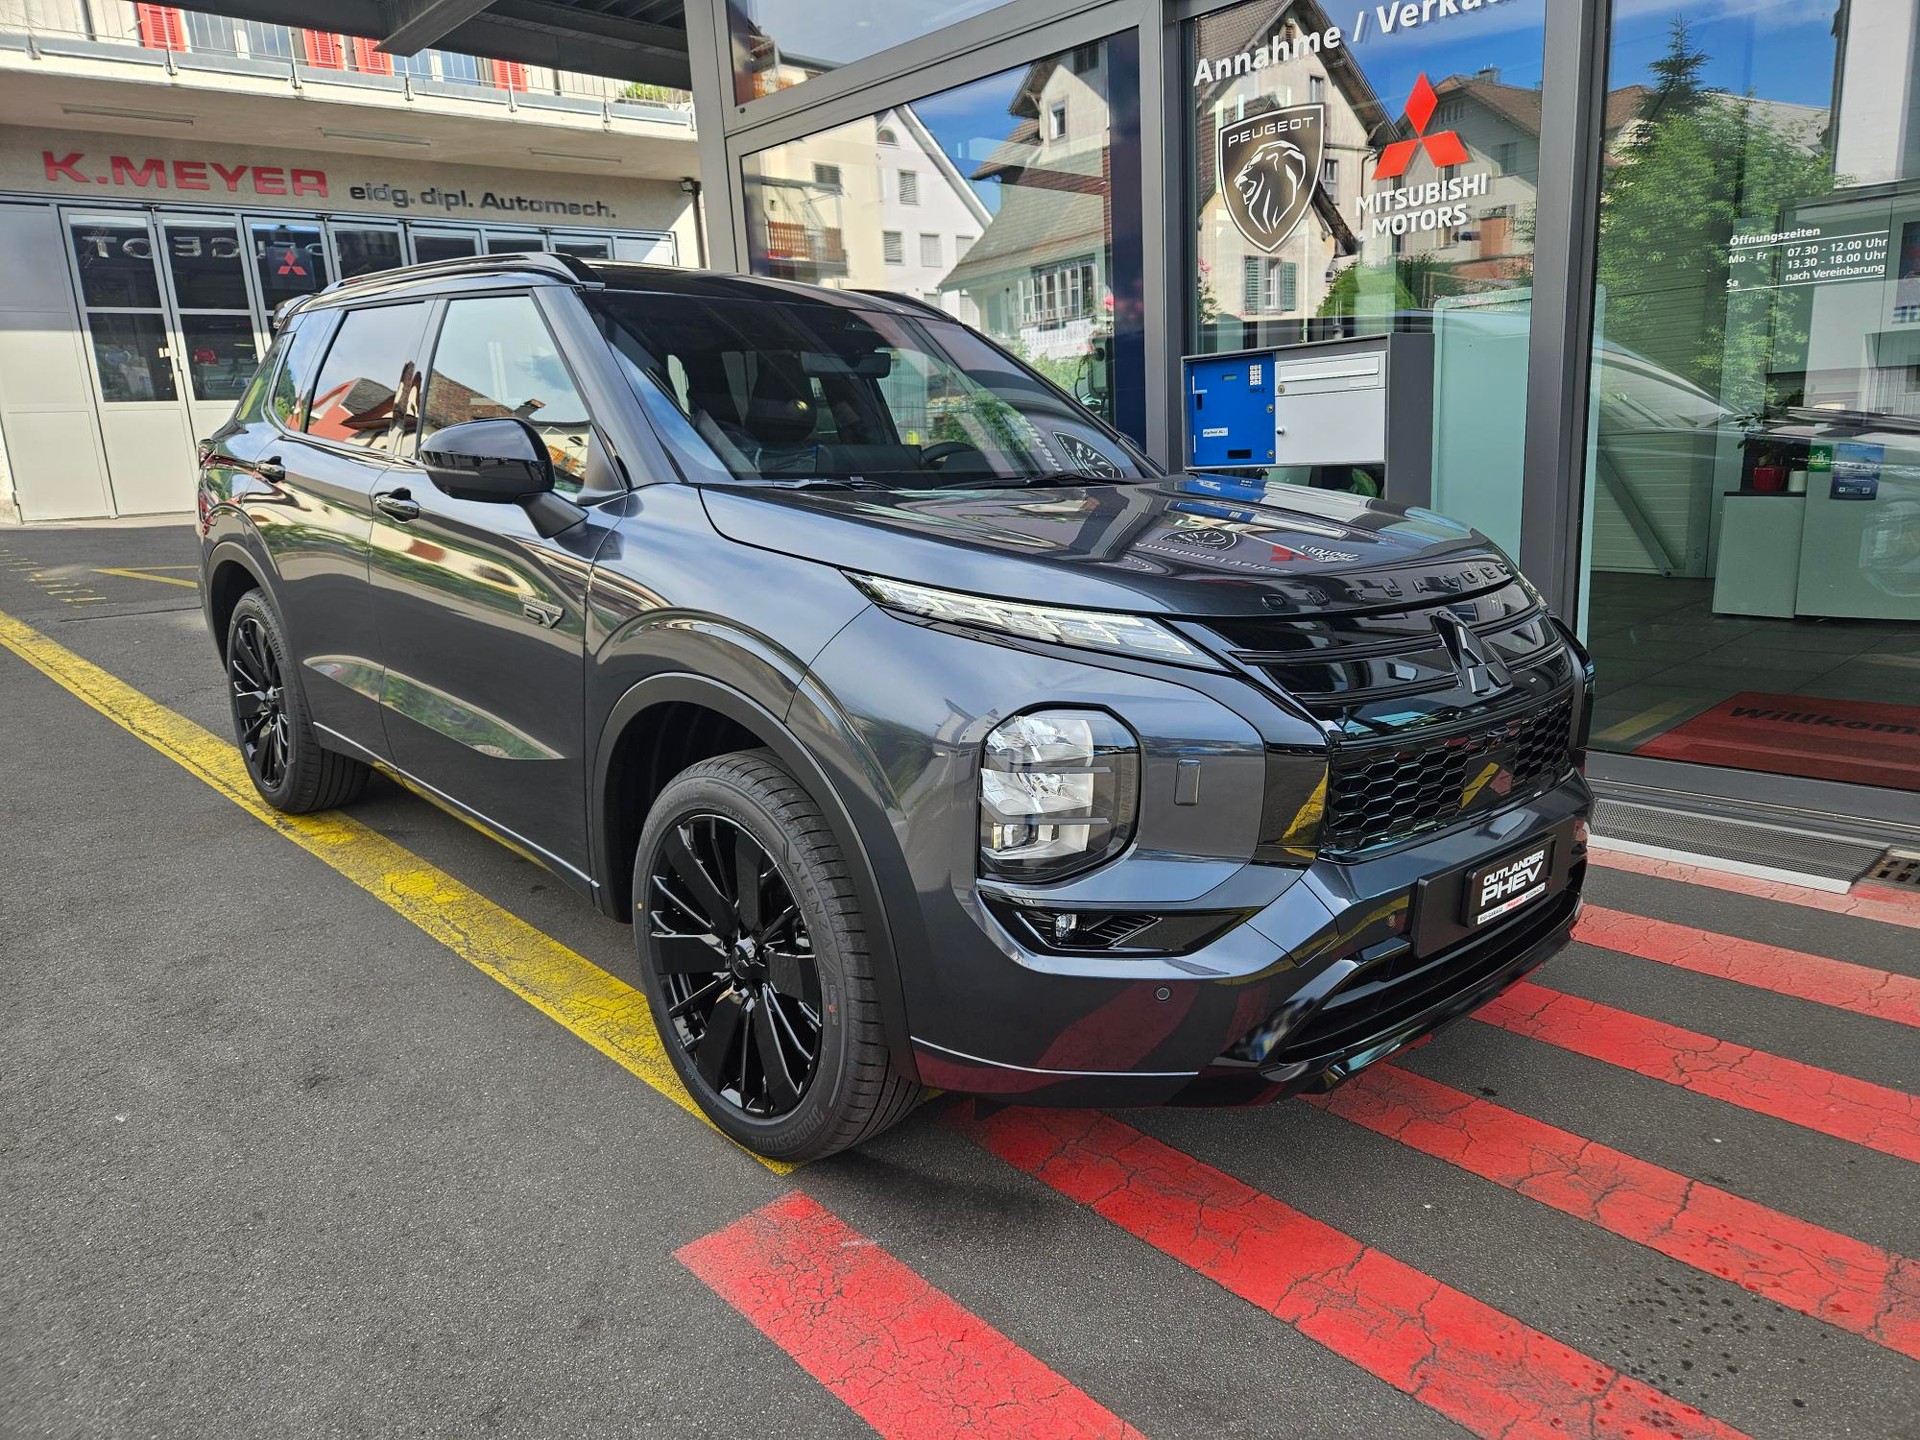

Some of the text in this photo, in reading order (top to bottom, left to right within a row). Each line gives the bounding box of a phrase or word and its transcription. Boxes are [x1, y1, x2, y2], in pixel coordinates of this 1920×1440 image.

[1193, 0, 1501, 86] Annahme / Verka
[1228, 116, 1314, 147] PEUGEOT
[42, 151, 328, 197] K.MEYER
[350, 183, 617, 218] eidg. dipl. Automech.
[1355, 173, 1487, 216] MITSUBISHI
[1372, 203, 1467, 238] MOTORS
[1729, 227, 1820, 246] Öffnungszeiten
[1728, 255, 1746, 264] Mo
[1757, 251, 1768, 261] Fr
[1787, 245, 1819, 257] 07.30
[1831, 240, 1862, 253] 12.00
[1866, 237, 1888, 249] Uhr
[1787, 257, 1818, 269] 13.30
[1830, 252, 1861, 265] 18.00
[1864, 249, 1887, 261] Uhr
[1726, 264, 1885, 288] Sa nach Vereinbarung
[1728, 707, 1920, 735] Willkom
[1480, 861, 1543, 907] PHEV
[1483, 850, 1544, 887] OUTLANDER
